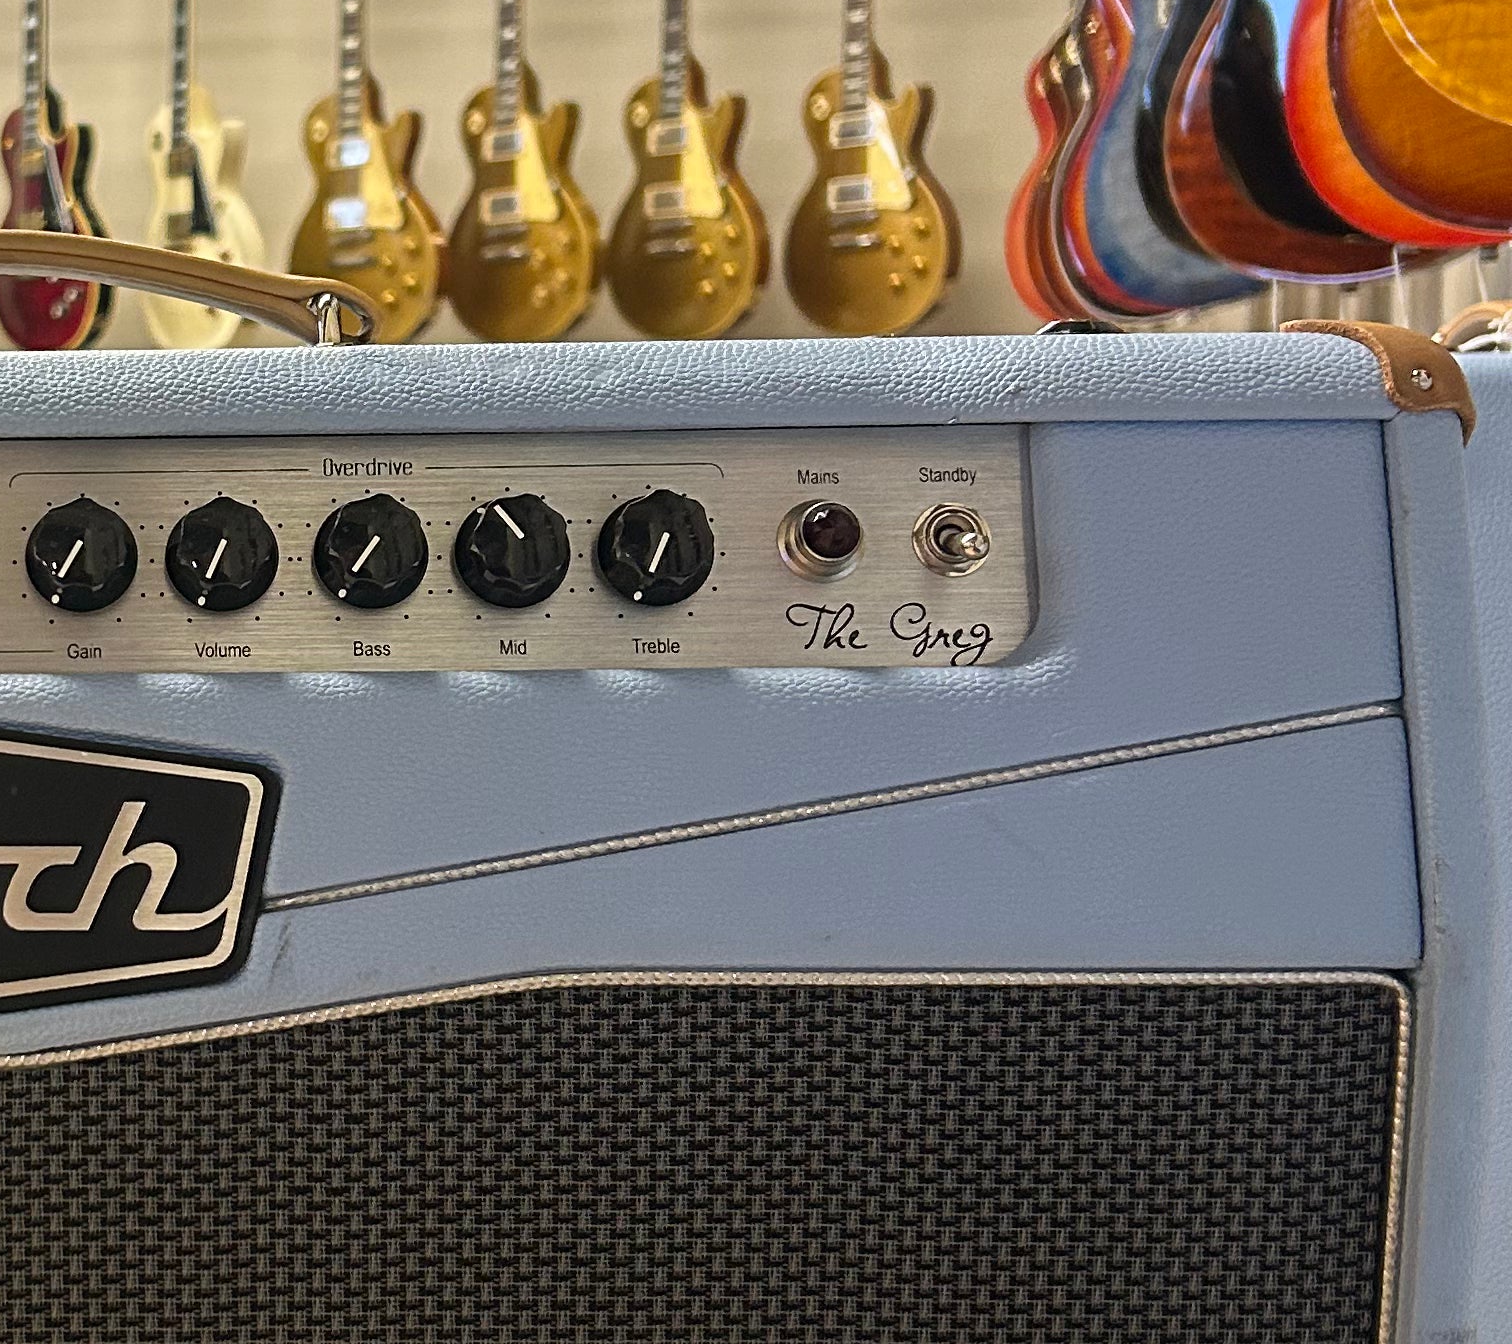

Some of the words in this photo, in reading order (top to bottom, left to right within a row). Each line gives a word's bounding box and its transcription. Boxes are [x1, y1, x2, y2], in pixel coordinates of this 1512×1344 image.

[322, 458, 413, 477] Overdrive
[919, 467, 976, 485] Standby
[797, 468, 839, 485] Mains
[786, 602, 868, 651] The
[890, 601, 994, 667] Greg
[67, 643, 102, 659] Gain
[195, 642, 251, 658] Volume
[353, 641, 391, 657] Bass
[499, 640, 527, 656] Mid
[632, 638, 681, 655] Treble
